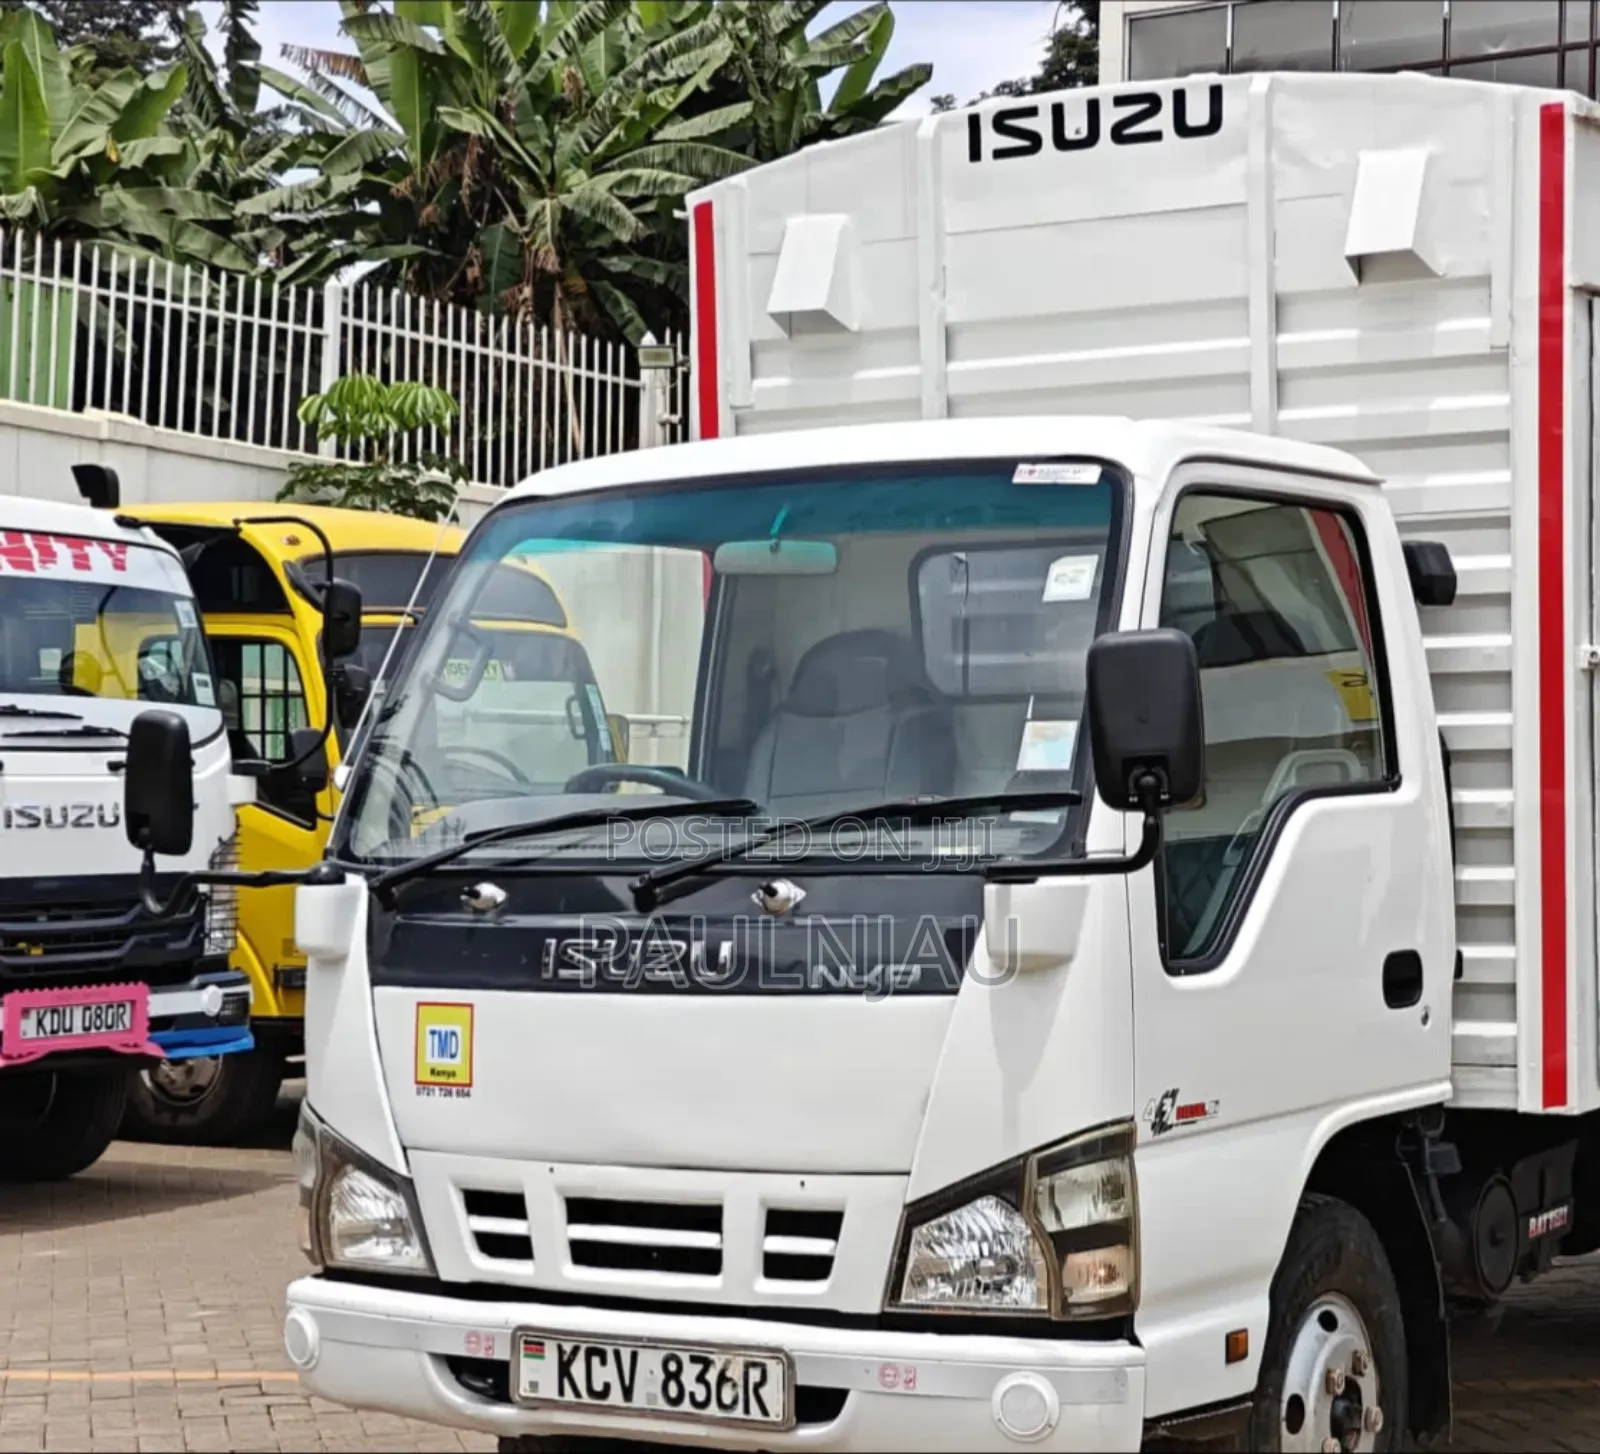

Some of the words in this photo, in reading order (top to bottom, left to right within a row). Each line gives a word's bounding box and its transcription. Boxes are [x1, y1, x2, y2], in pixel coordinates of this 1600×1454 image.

[967, 84, 1224, 163] ISUZU
[4, 802, 120, 828] ISUZU
[541, 938, 734, 981] ISUZU
[36, 1008, 74, 1037] KDU
[82, 1003, 127, 1032] 080R
[429, 1029, 459, 1060] TMD
[430, 1067, 457, 1079] Kenya
[557, 1343, 638, 1403] KCV
[661, 1352, 770, 1418] 836R
